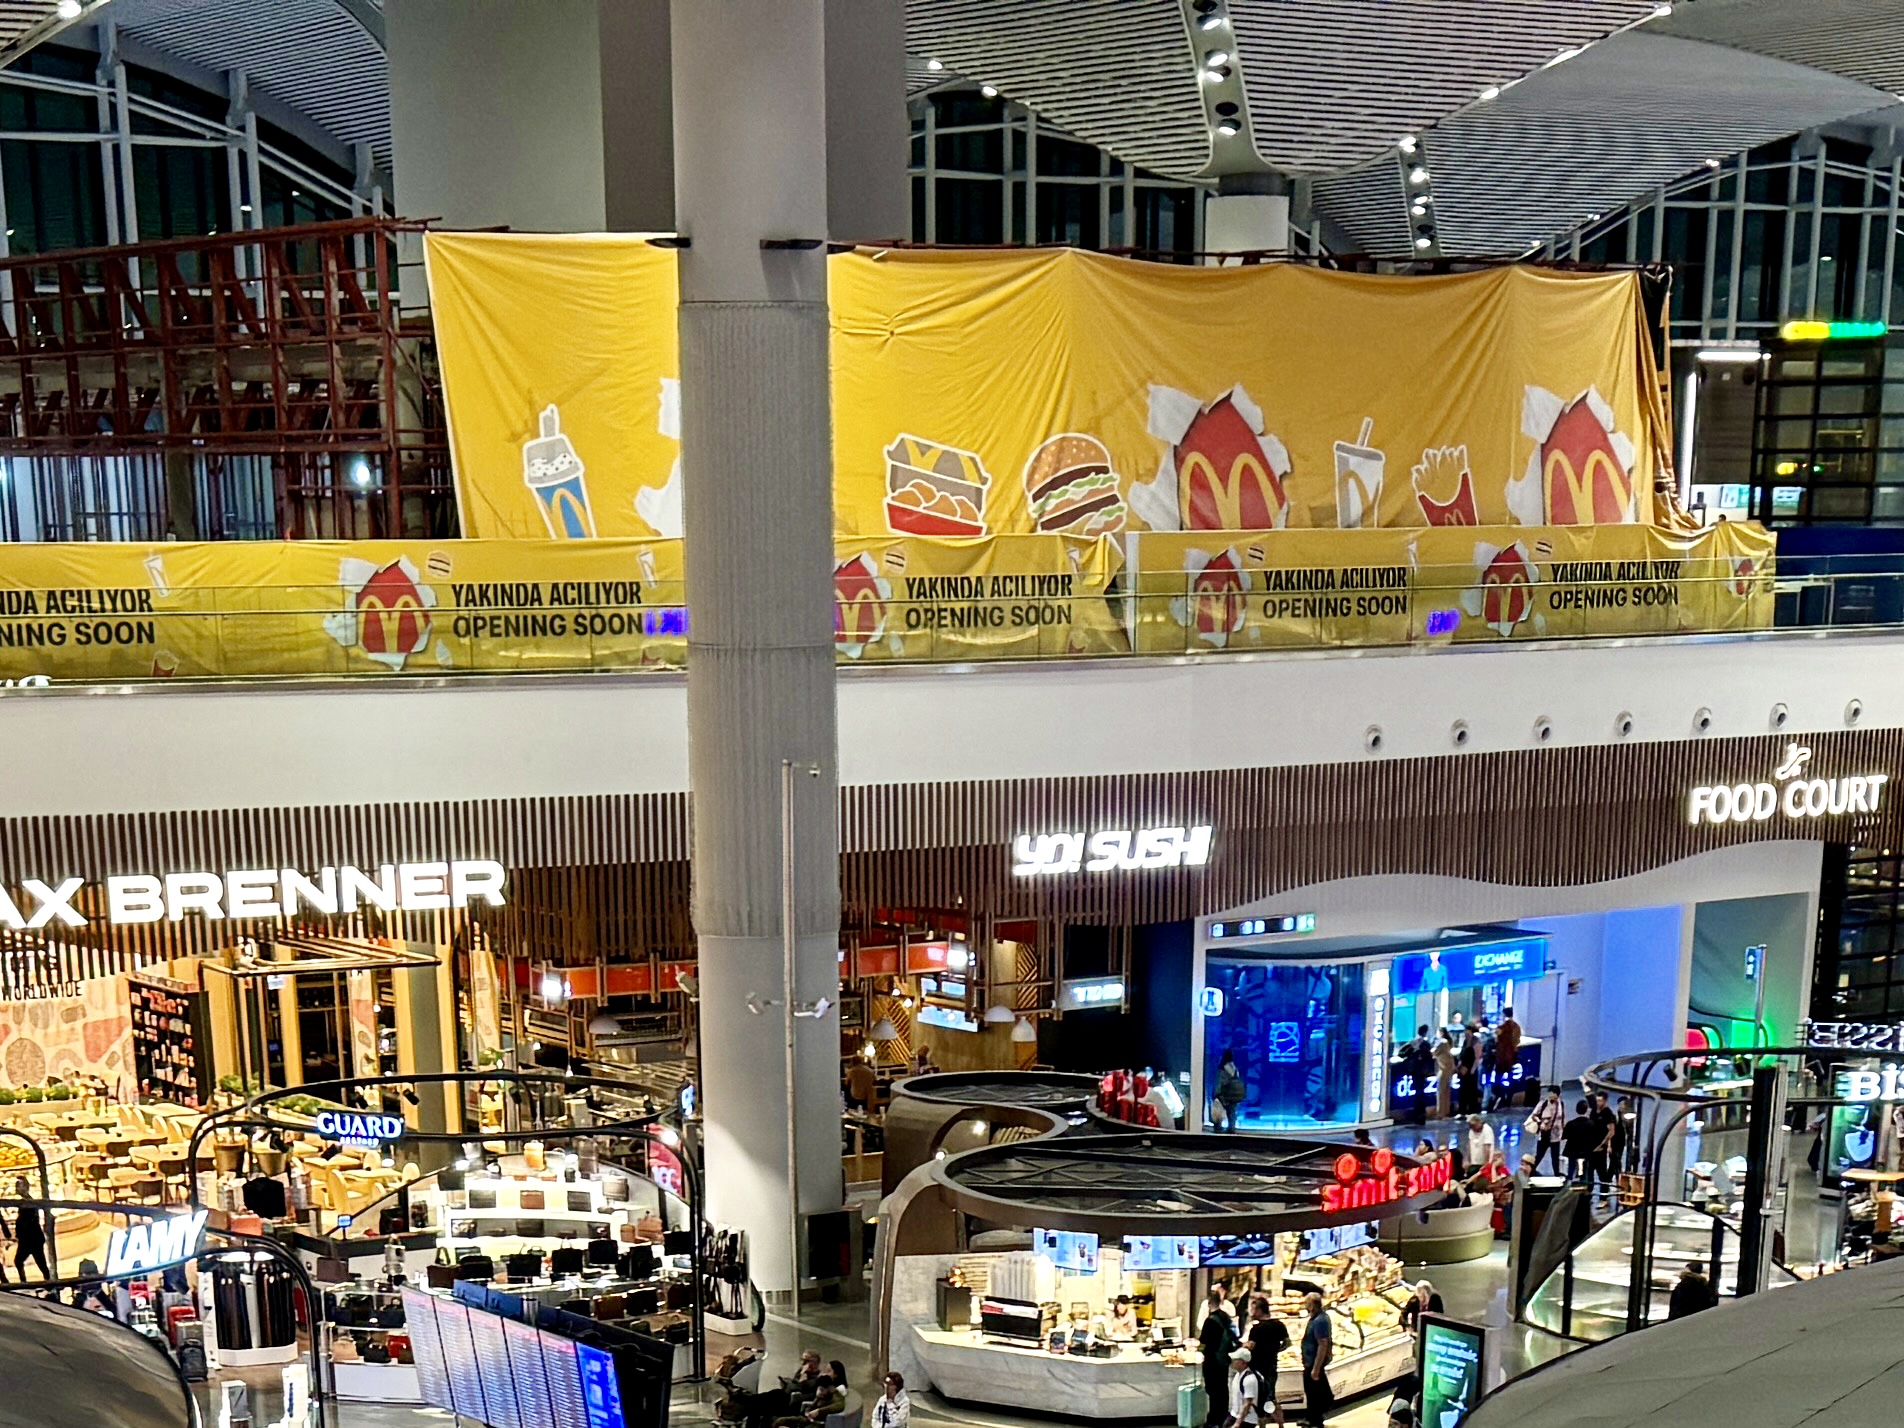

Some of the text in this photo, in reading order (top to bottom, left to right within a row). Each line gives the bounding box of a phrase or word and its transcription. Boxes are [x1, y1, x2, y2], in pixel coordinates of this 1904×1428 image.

[452, 583, 543, 608] YAKINDA
[904, 575, 984, 599] YAKINDA
[905, 602, 1072, 629] OPENING SOON
[1263, 593, 1407, 619] OPENING SOON
[75, 619, 156, 646] SOON
[453, 609, 643, 638] OPENING SOON
[1690, 775, 1887, 825] FOOD COURT
[1013, 825, 1213, 876] YO! SUSHI
[109, 860, 507, 925] BRENNER
[316, 1111, 404, 1139] GUARD
[106, 1209, 208, 1277] LAMY
